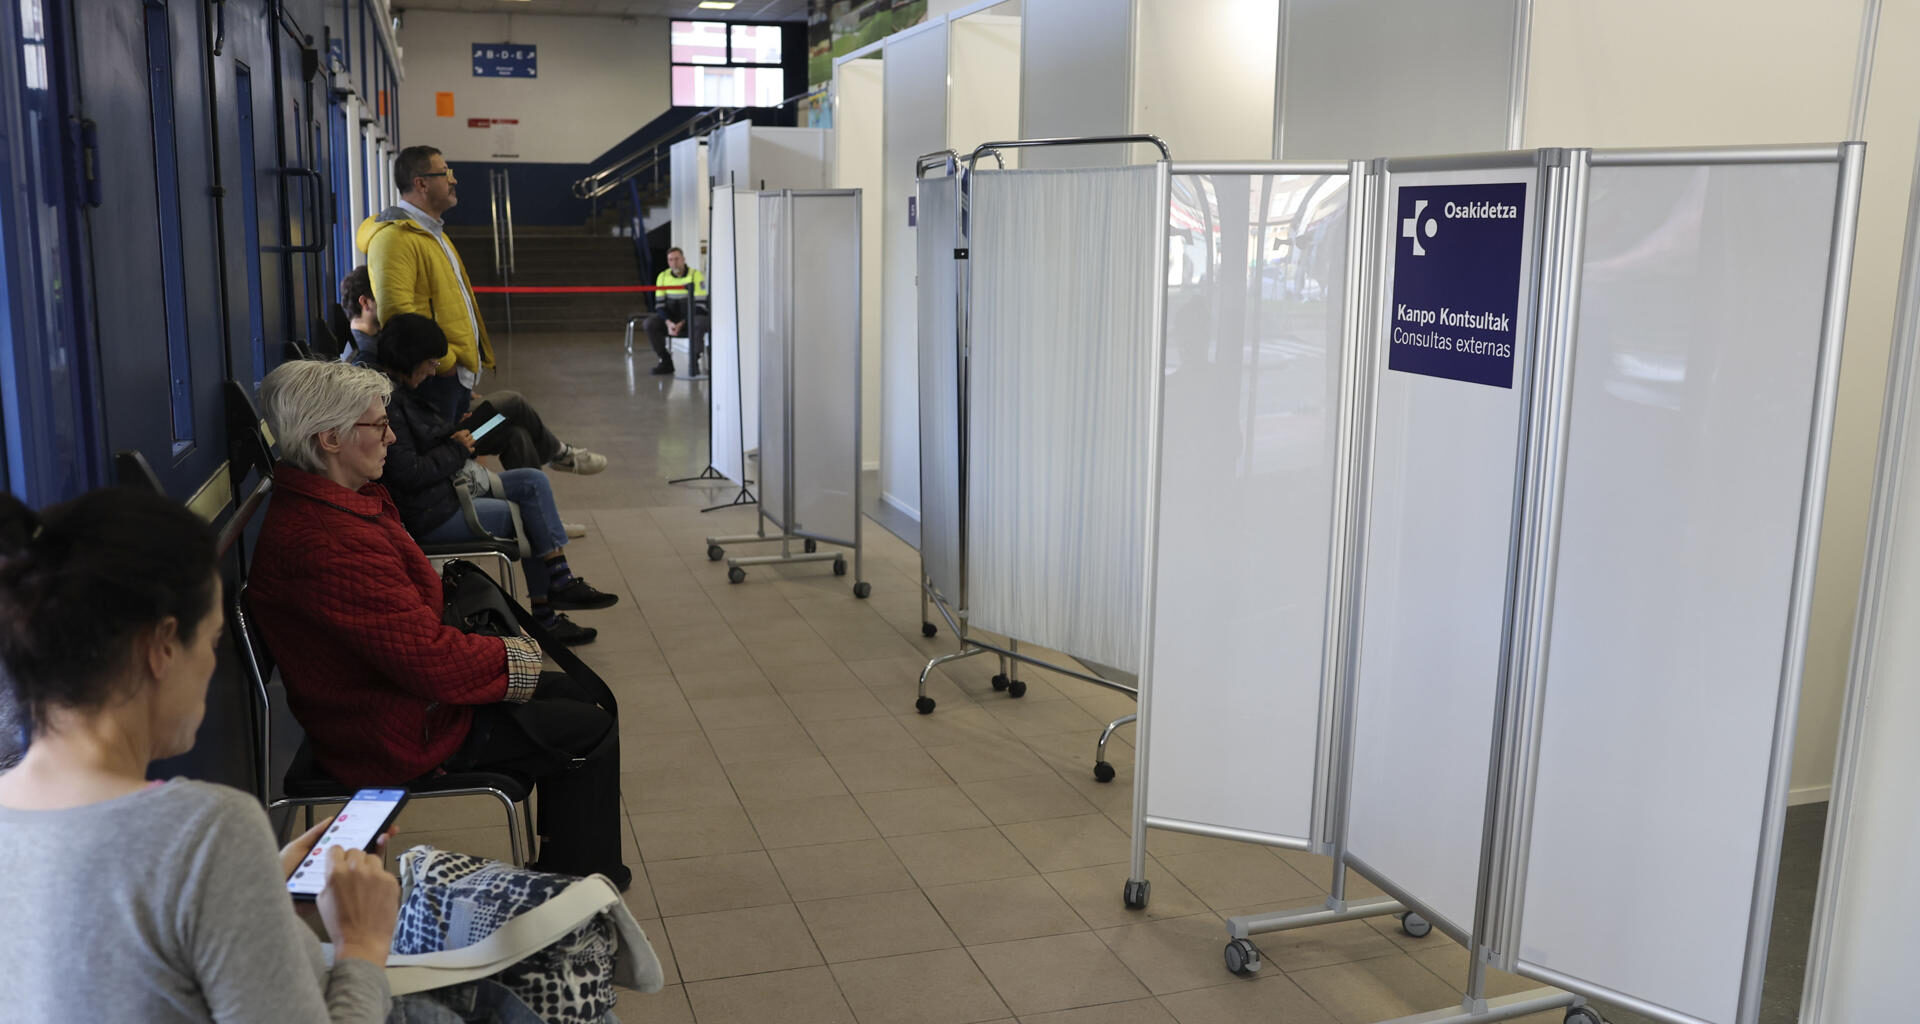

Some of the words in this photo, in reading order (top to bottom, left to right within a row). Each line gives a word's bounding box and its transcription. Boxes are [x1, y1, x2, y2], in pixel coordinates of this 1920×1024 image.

[1444, 201, 1518, 219] Osakidetza
[1397, 304, 1436, 326] Kanpo
[1439, 307, 1510, 332] Kontsultak
[1393, 327, 1452, 351] Consultas
[1456, 336, 1511, 358] externas
